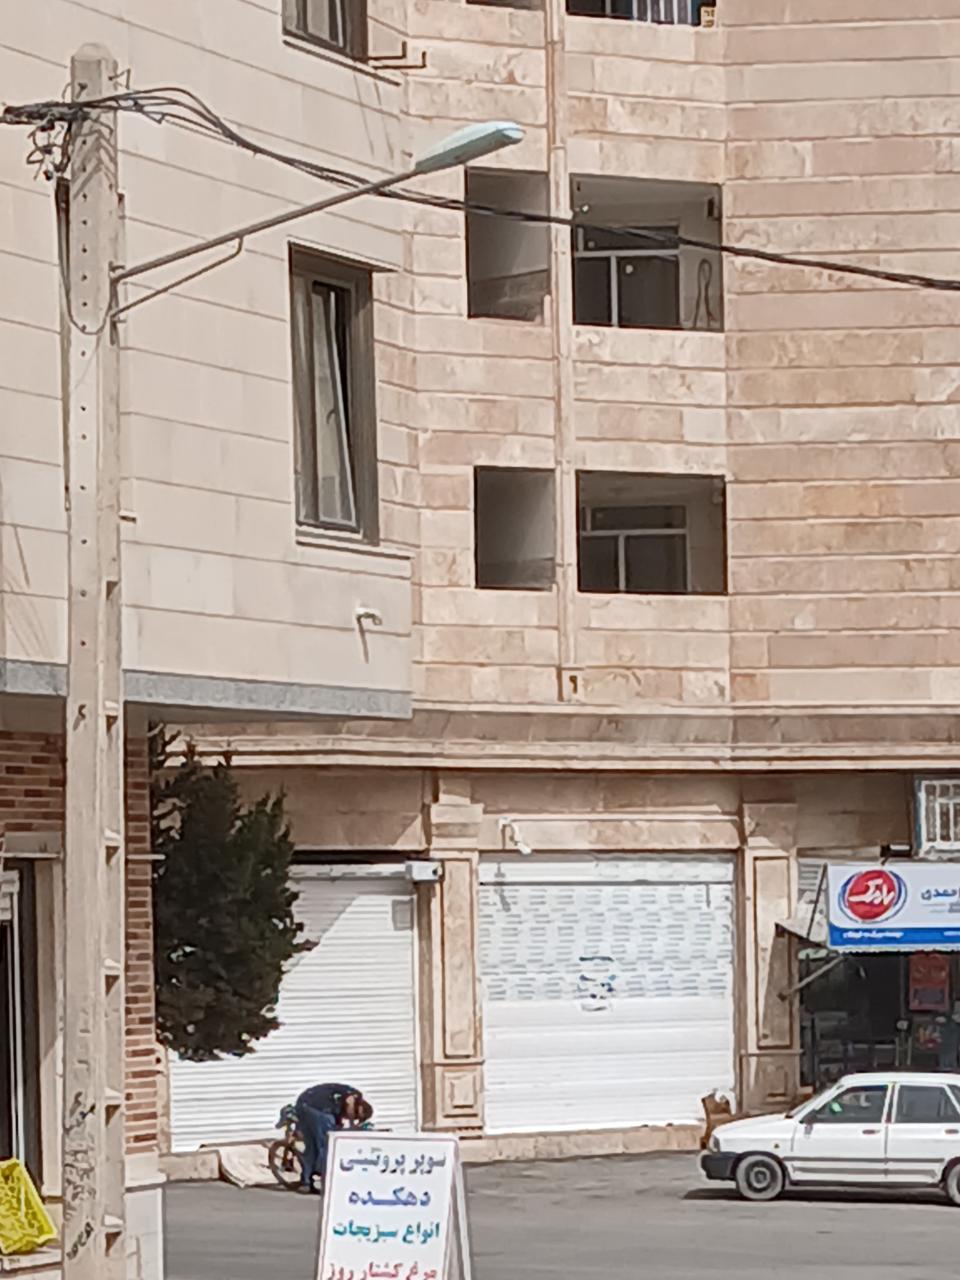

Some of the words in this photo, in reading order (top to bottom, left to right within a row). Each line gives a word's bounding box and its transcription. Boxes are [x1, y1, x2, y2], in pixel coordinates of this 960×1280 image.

[409, 1152, 447, 1175] سوپر
[348, 1186, 432, 1206] دهکده
[332, 1219, 399, 1243] سبزیجات
[402, 1220, 441, 1244] انواع
